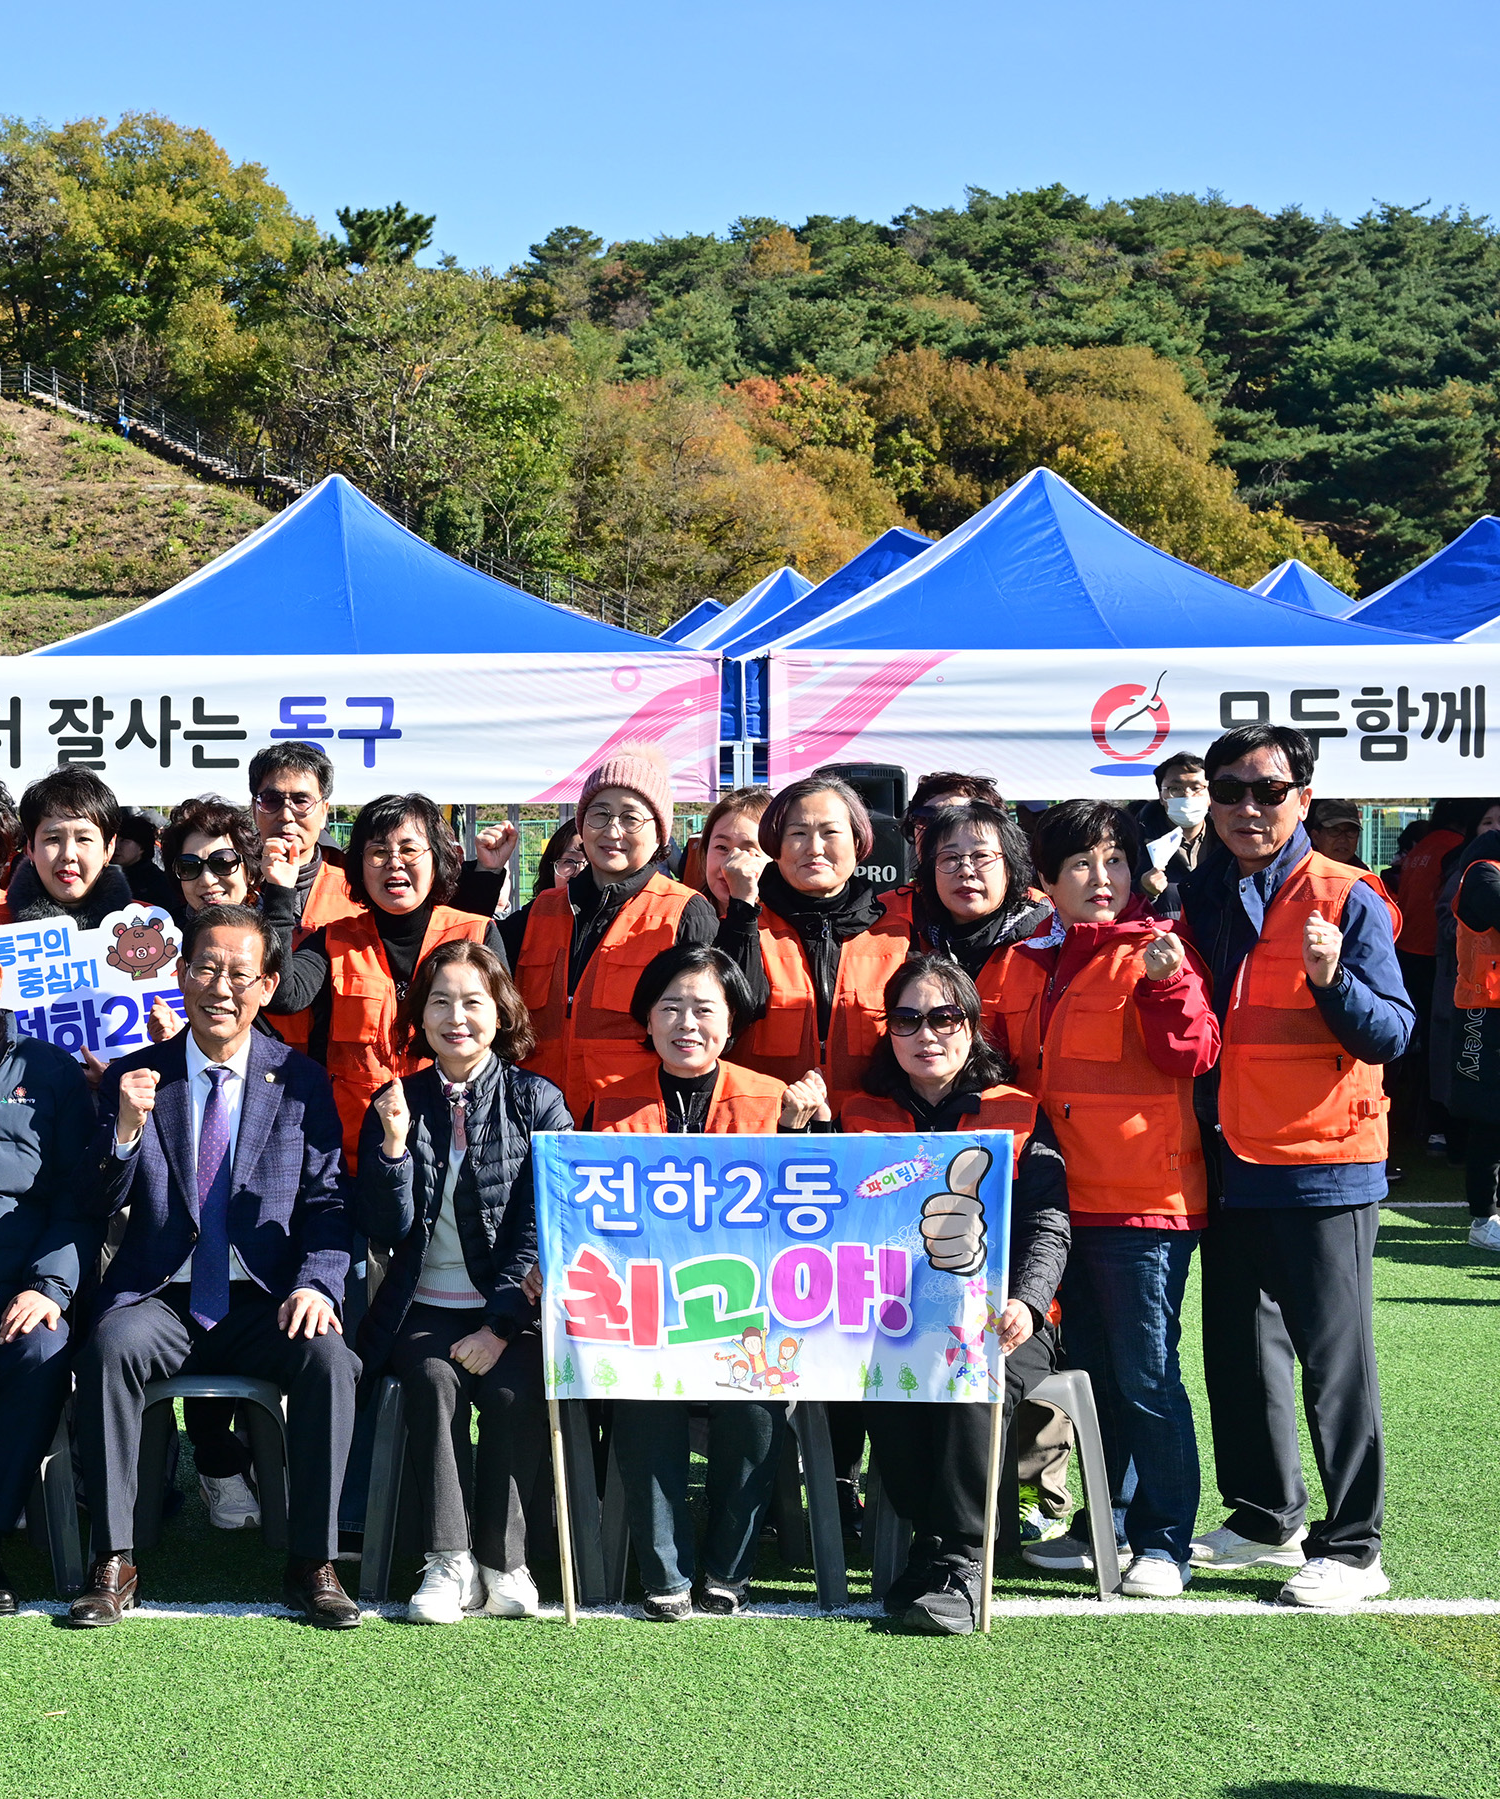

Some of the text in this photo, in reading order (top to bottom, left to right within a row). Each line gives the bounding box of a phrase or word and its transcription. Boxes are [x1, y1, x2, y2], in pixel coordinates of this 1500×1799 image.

[47, 695, 247, 771] 잘사는
[269, 696, 403, 768] 동구
[853, 865, 897, 882] PRO
[17, 959, 100, 999] 중심지
[573, 1161, 842, 1234] 전하2동
[866, 1162, 919, 1194] 파이팅!
[563, 1247, 909, 1347] 최고야!
